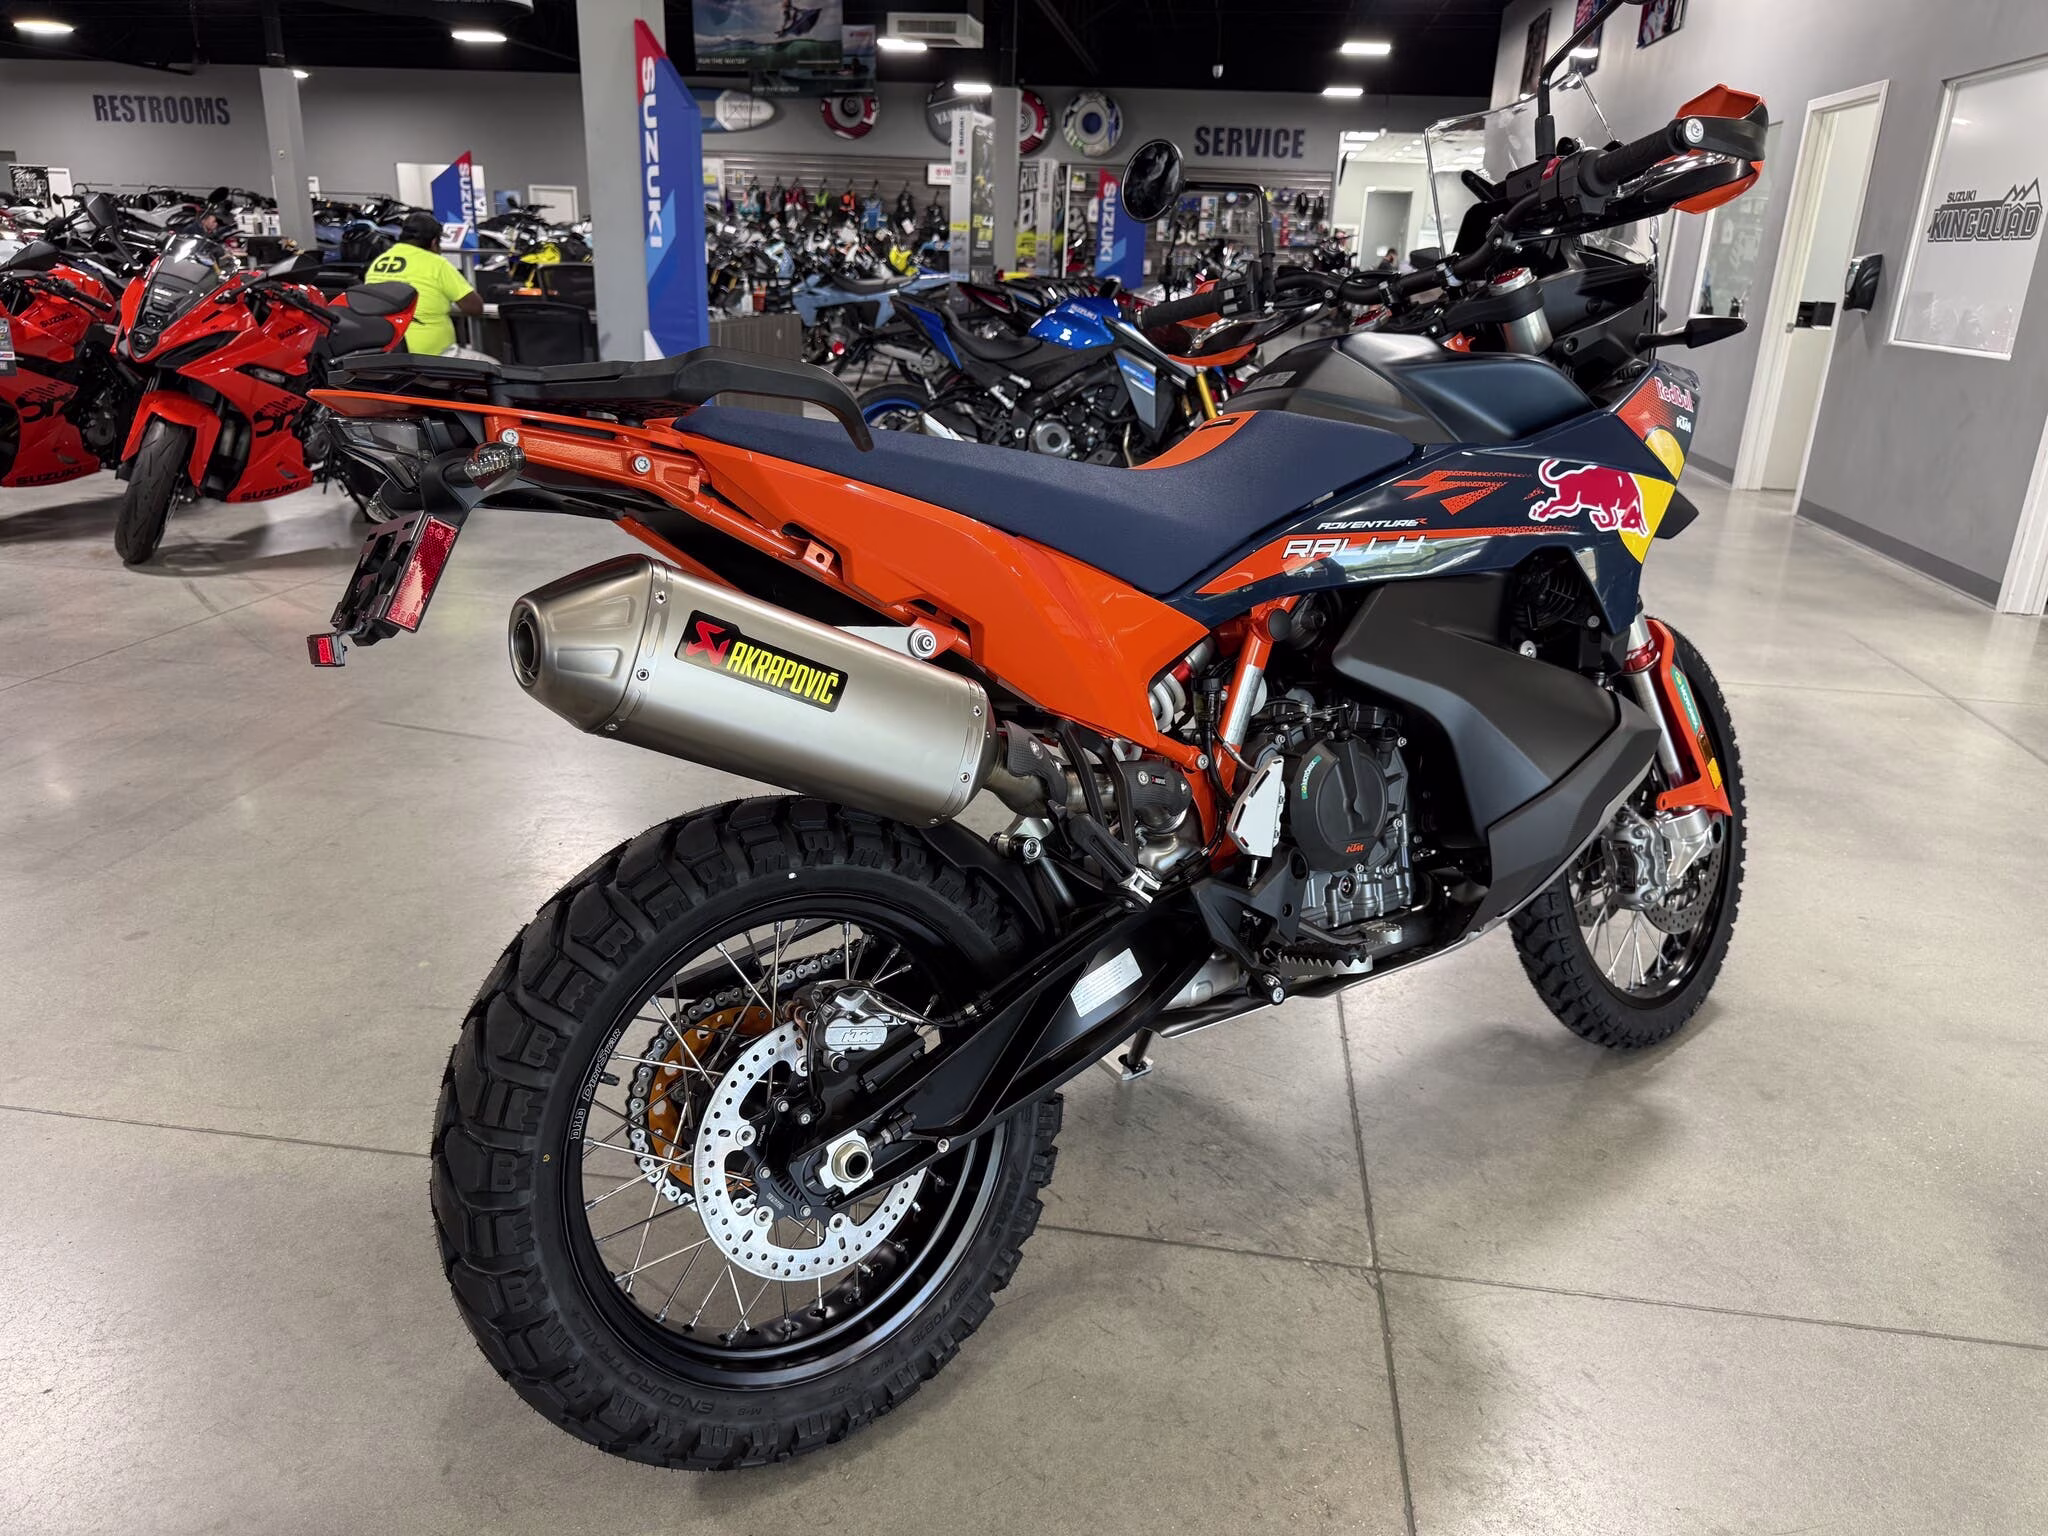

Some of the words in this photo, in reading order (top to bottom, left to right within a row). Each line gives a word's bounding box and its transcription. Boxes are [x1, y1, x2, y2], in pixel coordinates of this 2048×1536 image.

[93, 95, 230, 125] RESTROOMS
[642, 56, 663, 248] SUZUKI
[1194, 126, 1305, 159] SERVICE
[1947, 190, 1977, 203] SUZUKI
[1100, 182, 1117, 262] SUZUKI
[1928, 202, 2042, 242] KINGQUAD
[40, 312, 73, 328] SUZUKI
[1676, 415, 1692, 433] KTM
[16, 466, 82, 486] SUZUKI
[240, 482, 300, 501] SUZUKI
[1282, 535, 1426, 558] RALLY
[1346, 843, 1364, 853] KTM
